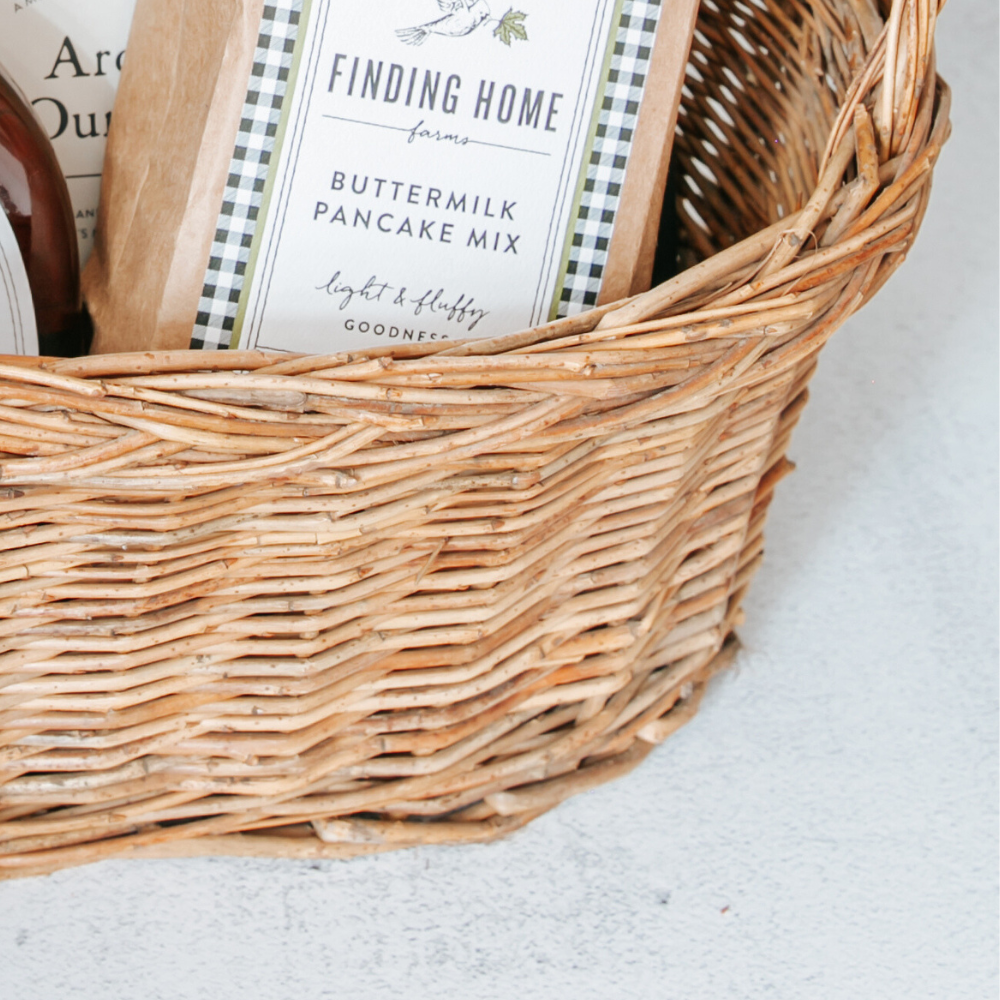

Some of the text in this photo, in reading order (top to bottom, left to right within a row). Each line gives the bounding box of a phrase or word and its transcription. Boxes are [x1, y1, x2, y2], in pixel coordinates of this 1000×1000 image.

[13, 2, 23, 13] A
[327, 53, 564, 133] FINDING HOME
[407, 120, 472, 145] farms
[330, 171, 518, 221] BUTTERMILK
[313, 201, 521, 255] PANCAKE MIX
[315, 271, 490, 332] light & fluffy
